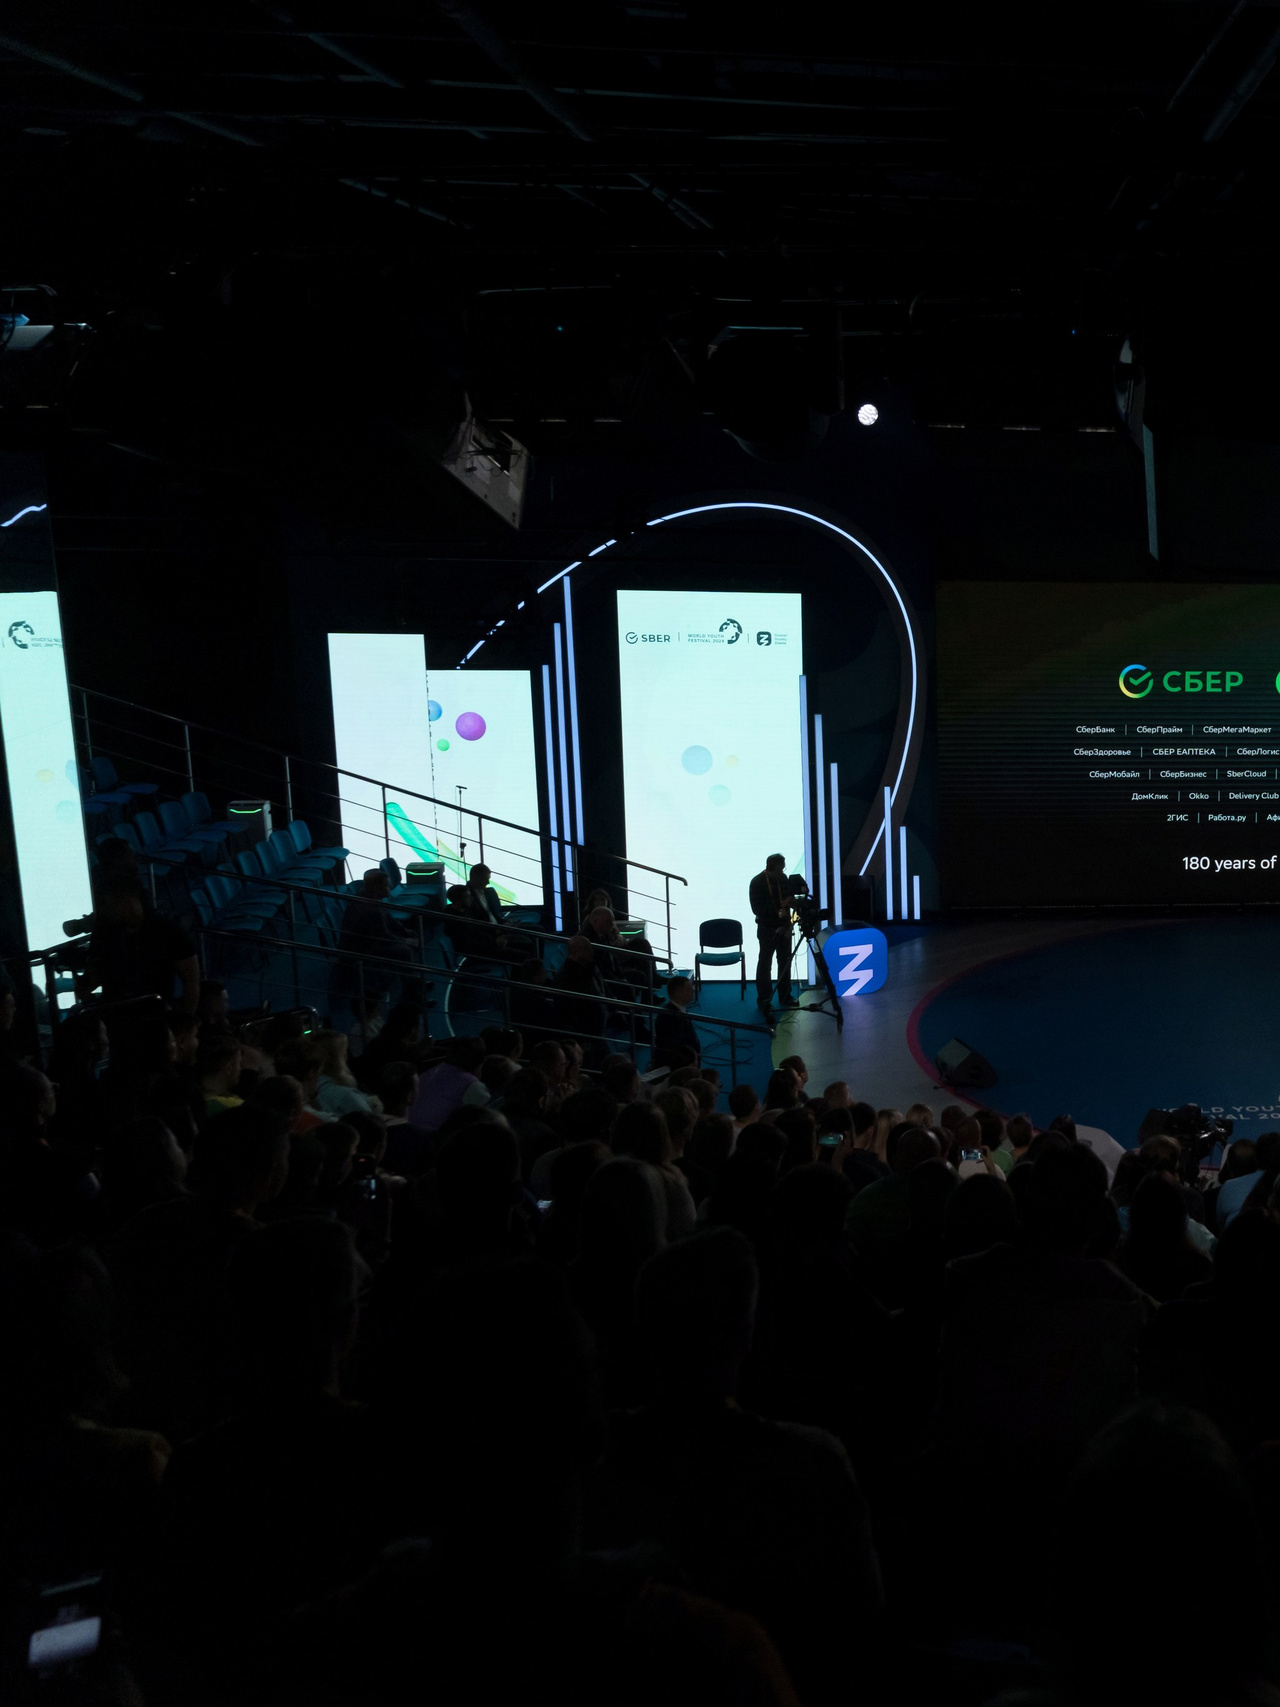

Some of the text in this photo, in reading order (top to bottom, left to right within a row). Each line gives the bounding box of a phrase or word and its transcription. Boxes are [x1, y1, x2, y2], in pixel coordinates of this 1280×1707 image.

[641, 634, 671, 643] SBER
[1162, 670, 1244, 693] СБЕР
[1075, 725, 1116, 736] СберБанк
[1136, 725, 1183, 736] СберПрайм
[1202, 725, 1272, 736] СберМегаМаркет
[1073, 747, 1132, 757] СберЗдоровье
[1152, 747, 1175, 757] СБЕР
[1176, 747, 1216, 757] ЕАПТЕКА
[1088, 769, 1140, 779] СберМобайл
[1159, 769, 1207, 779] СберБизнес
[1226, 769, 1267, 779] SberCloud
[1131, 791, 1169, 801] ДомКлик
[1188, 791, 1210, 801] Okko
[1228, 791, 1260, 801] Delivery
[1261, 791, 1280, 801] Club
[1166, 813, 1189, 823] 2ГИС
[1208, 813, 1247, 823] Работа.ру
[1182, 856, 1211, 870] 180
[1214, 858, 1256, 874] years
[1260, 854, 1278, 870] of
